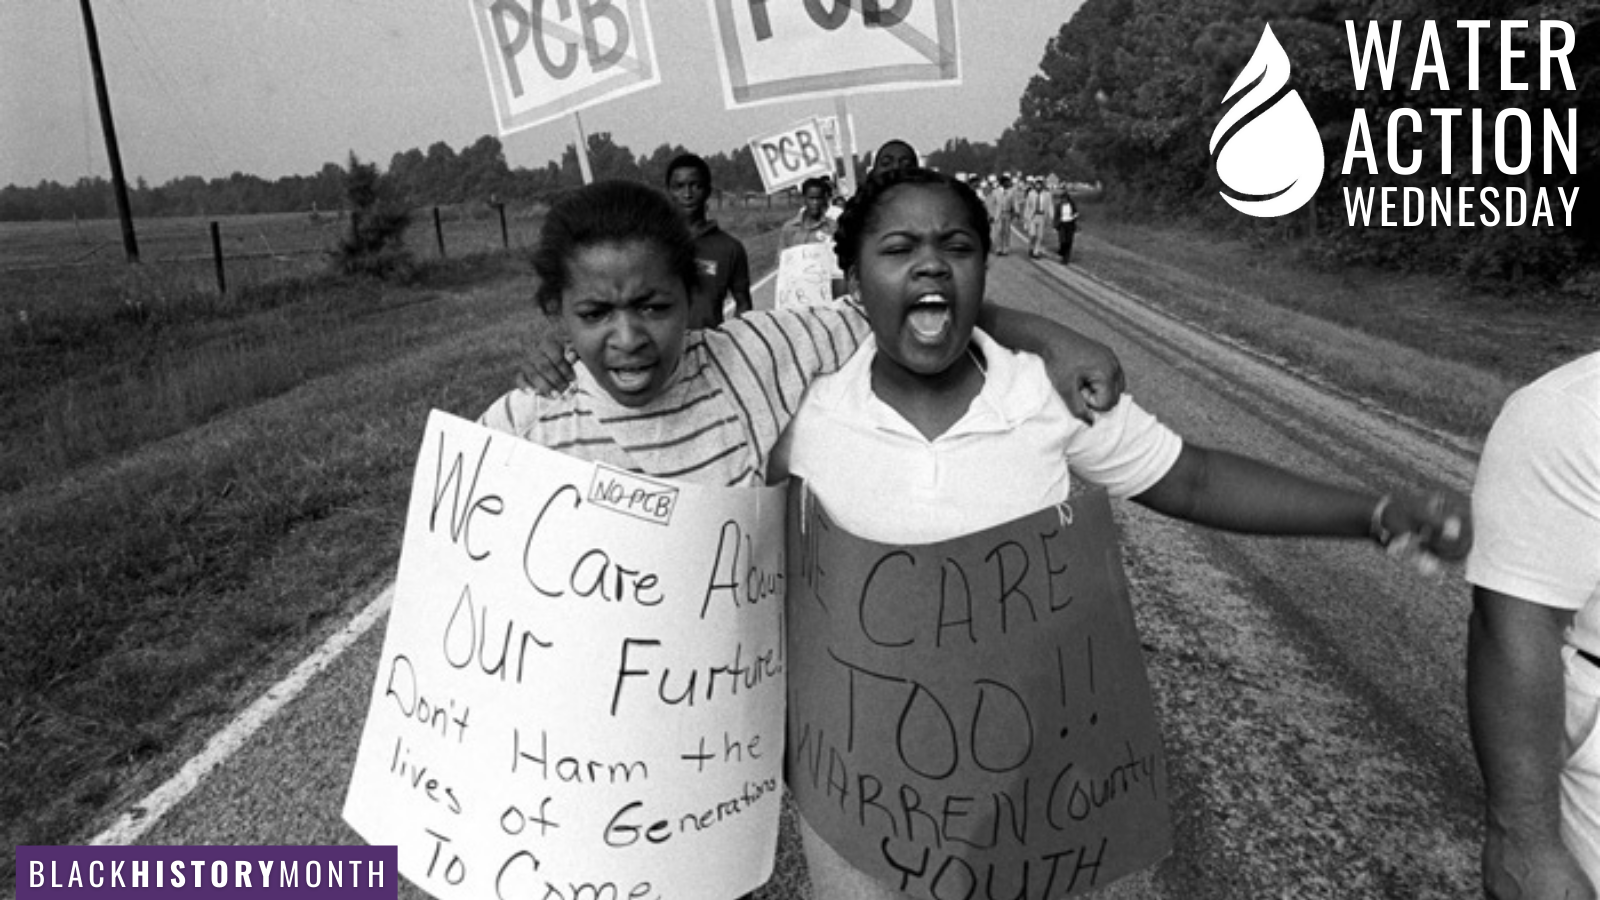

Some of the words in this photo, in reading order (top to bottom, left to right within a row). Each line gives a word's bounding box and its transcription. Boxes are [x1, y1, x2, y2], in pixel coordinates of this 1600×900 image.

[761, 130, 820, 178] PCB
[429, 430, 504, 561] We
[523, 484, 665, 606] Care
[859, 529, 1073, 648] CARE
[385, 655, 470, 743] Don't
[511, 728, 648, 783] Harm
[680, 731, 764, 772] the
[390, 736, 462, 815] lives
[499, 796, 560, 836] of
[796, 720, 1029, 850] WARREN
[881, 836, 1108, 900] YOUTH
